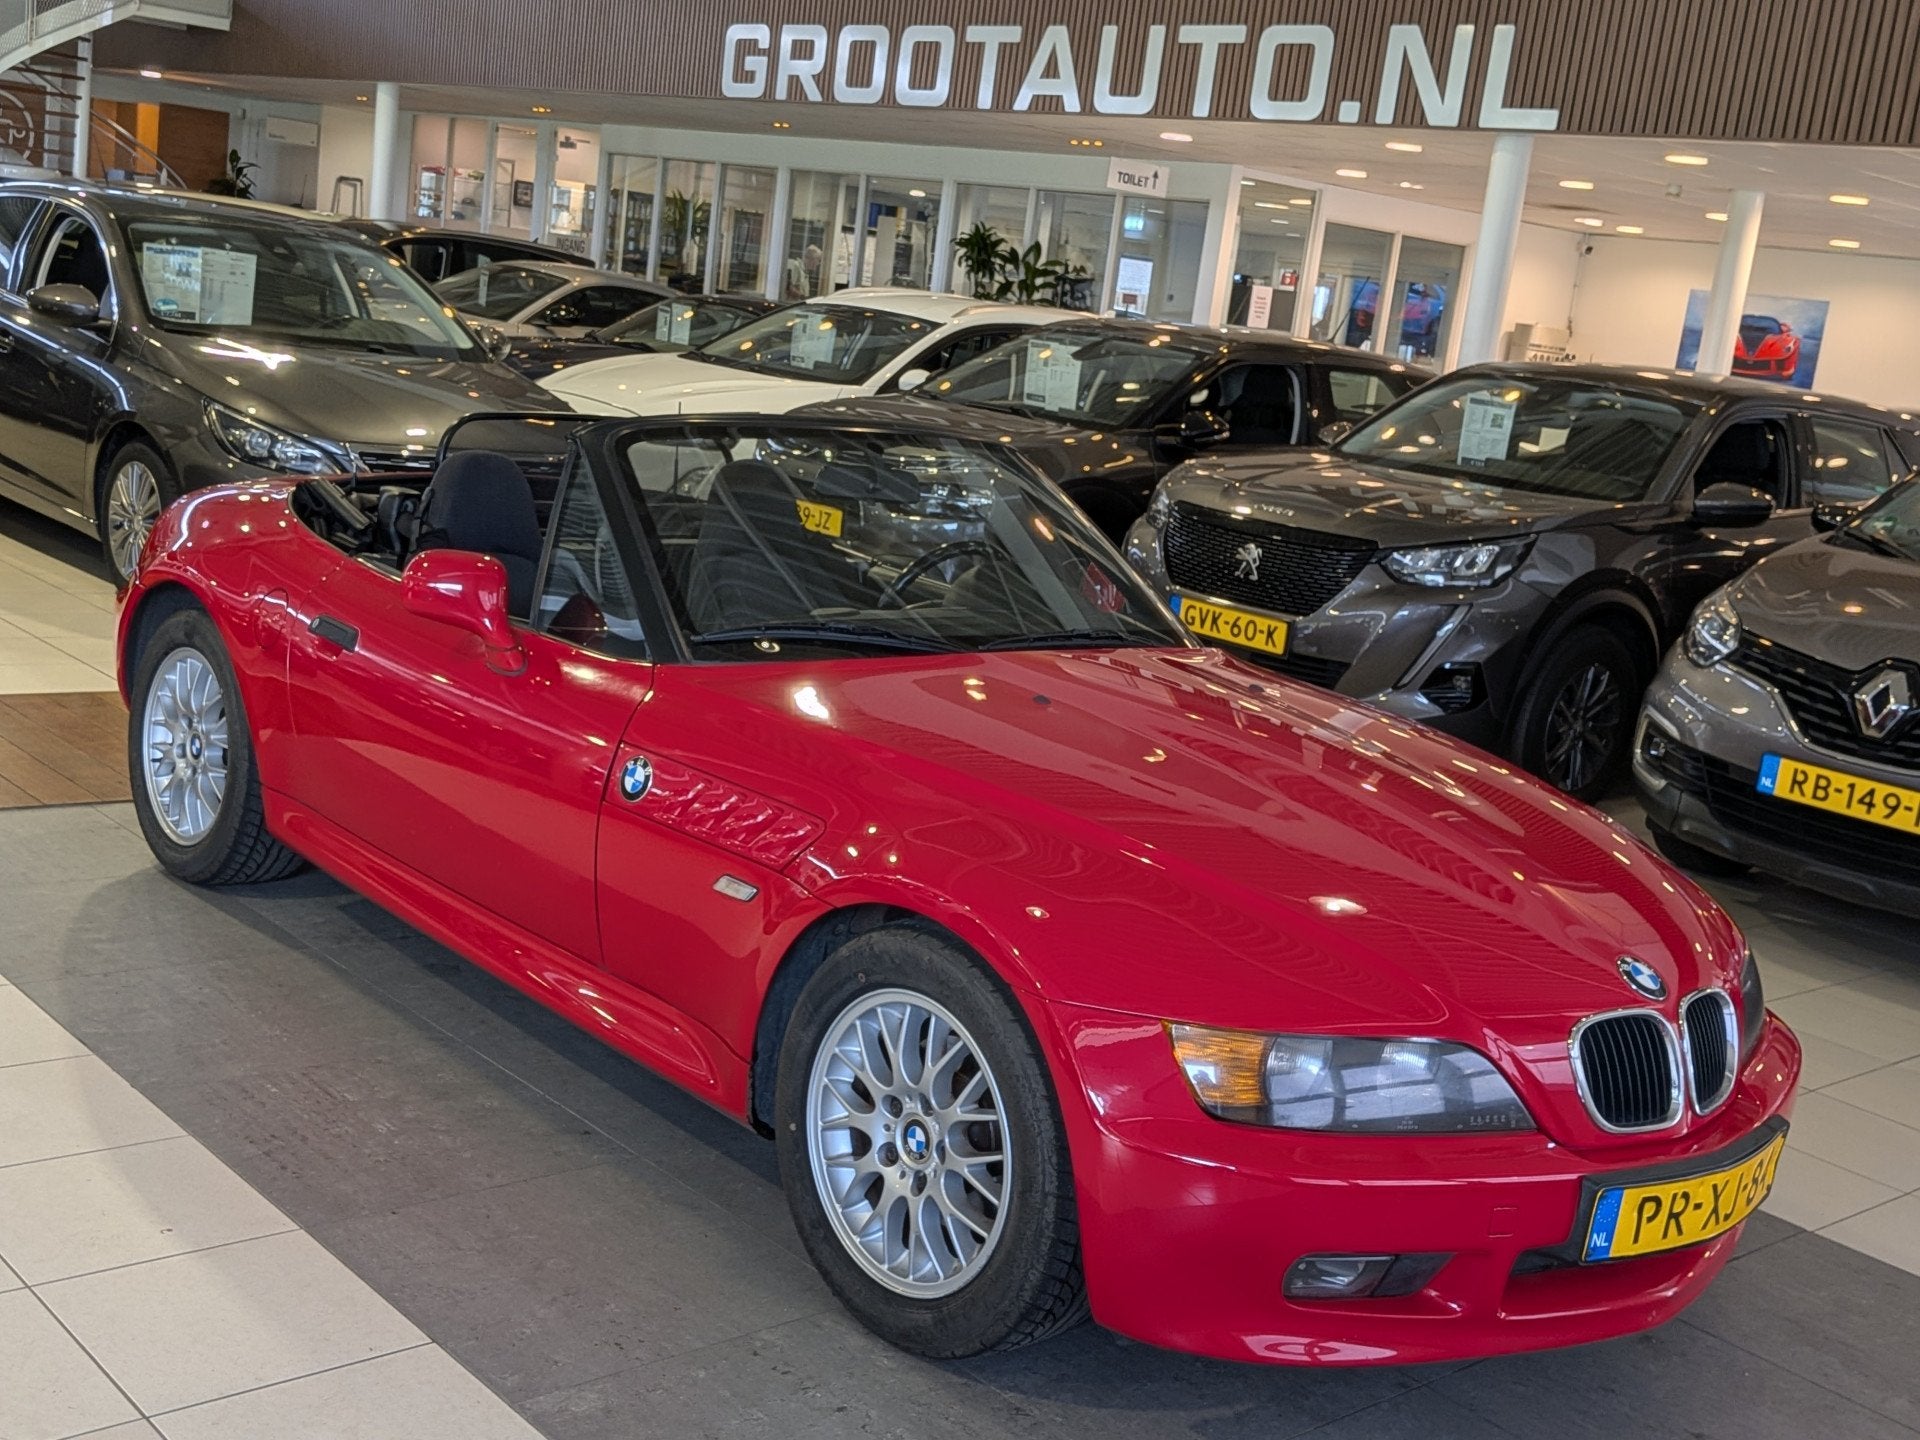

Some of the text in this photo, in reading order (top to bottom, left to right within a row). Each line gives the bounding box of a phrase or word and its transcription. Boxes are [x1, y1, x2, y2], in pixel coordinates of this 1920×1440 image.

[721, 23, 1560, 131] GROOTAUTO.NL
[1117, 170, 1149, 188] TOILET
[556, 237, 586, 254] INGANG
[1183, 604, 1279, 648] GVK-60-K
[1760, 776, 1774, 788] NL
[1788, 767, 1920, 828] RB-149-
[1590, 1231, 1609, 1248] NL
